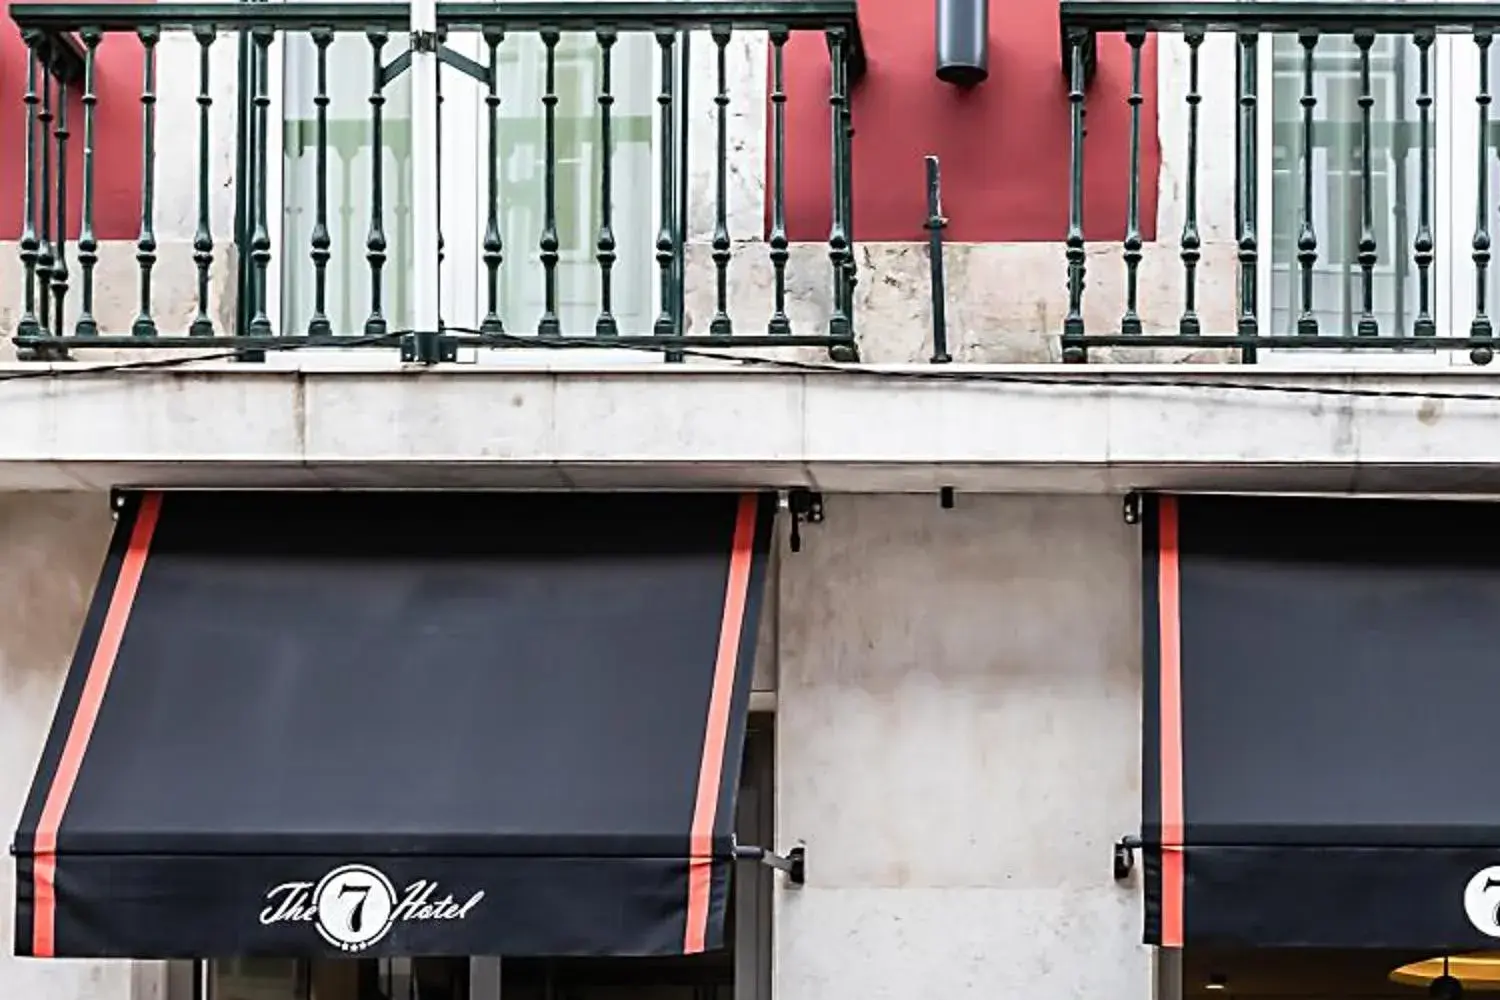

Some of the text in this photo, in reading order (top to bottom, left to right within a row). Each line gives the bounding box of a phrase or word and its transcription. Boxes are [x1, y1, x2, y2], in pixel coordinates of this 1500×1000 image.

[260, 879, 485, 933] The 7 Hotel
